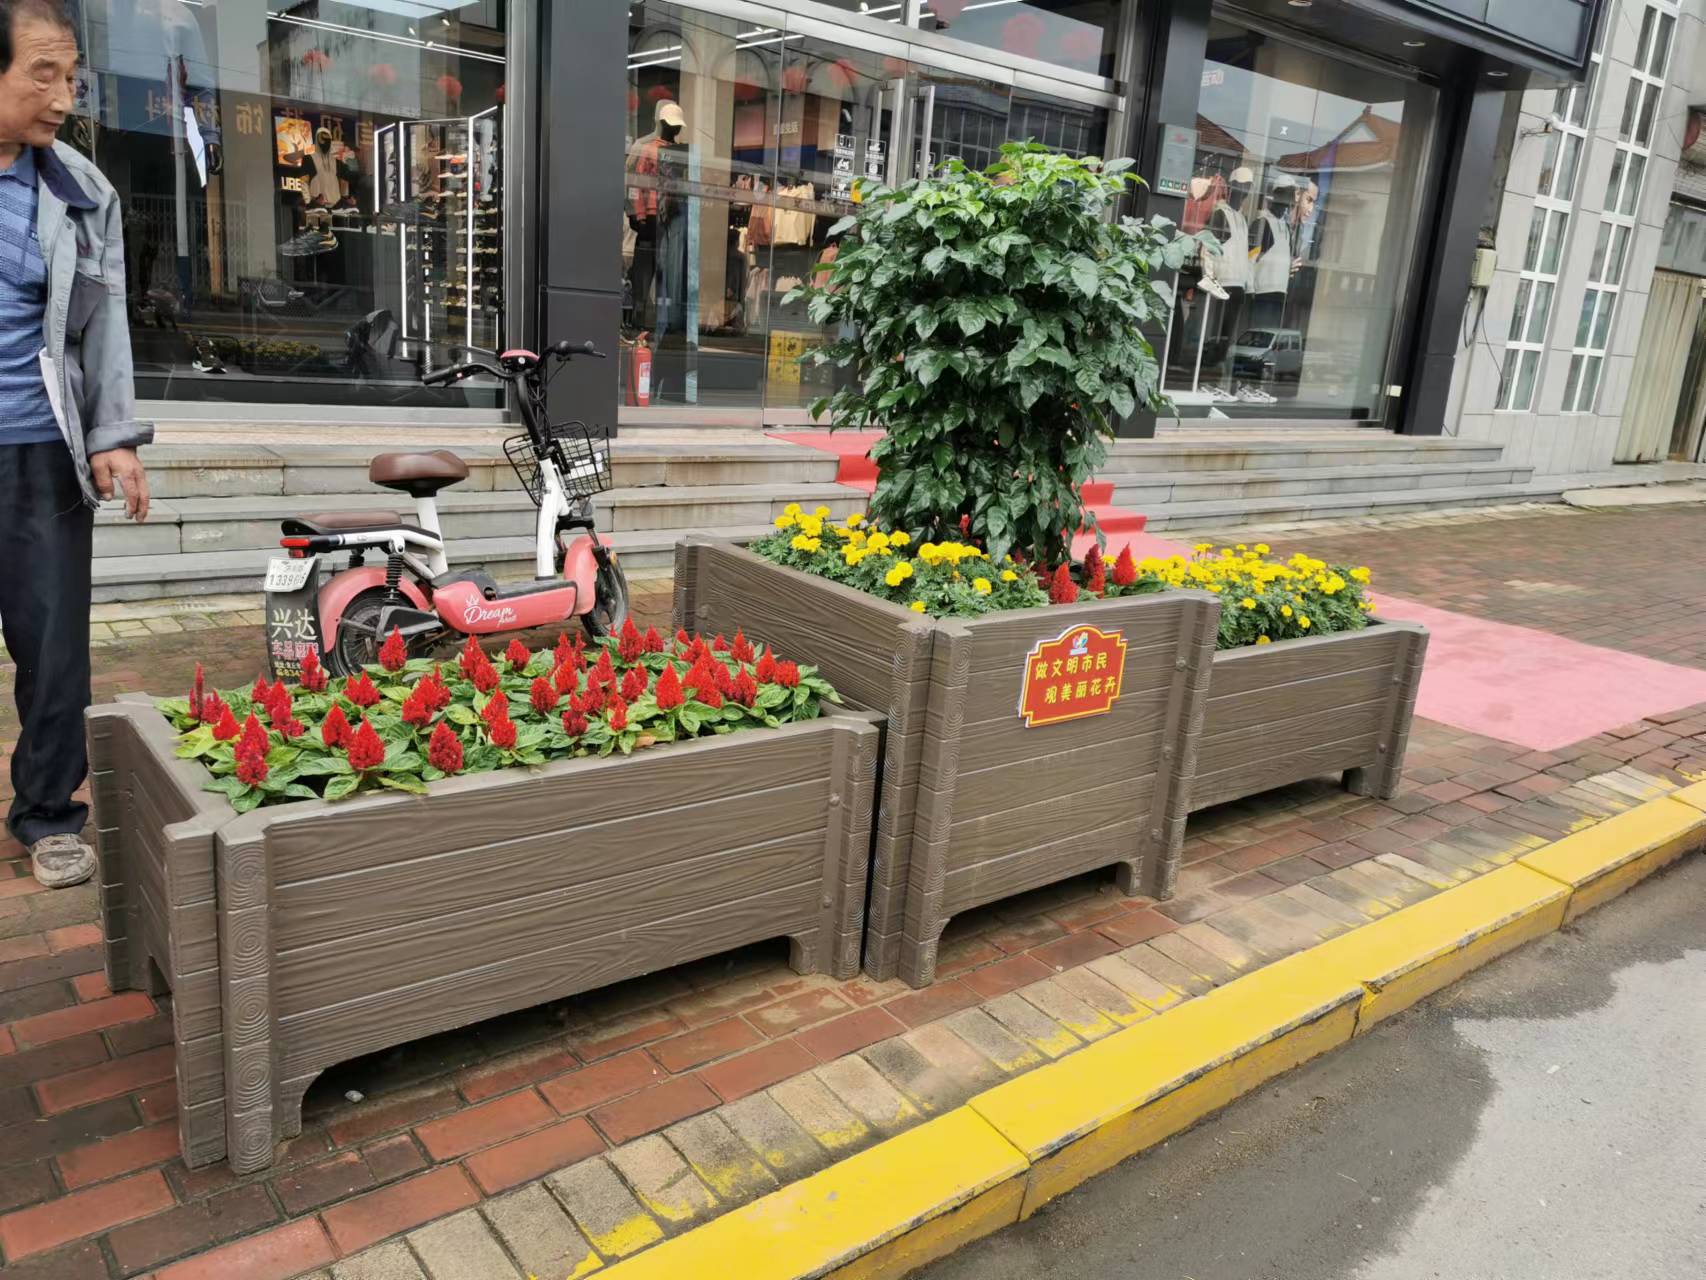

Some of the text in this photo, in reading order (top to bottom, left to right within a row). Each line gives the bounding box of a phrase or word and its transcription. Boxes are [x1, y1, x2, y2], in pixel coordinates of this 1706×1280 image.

[271, 607, 318, 641] 兴达
[463, 605, 513, 625] Dream
[1035, 652, 1108, 680] 做文明市民
[1044, 675, 1117, 704] 观美丽花卉
